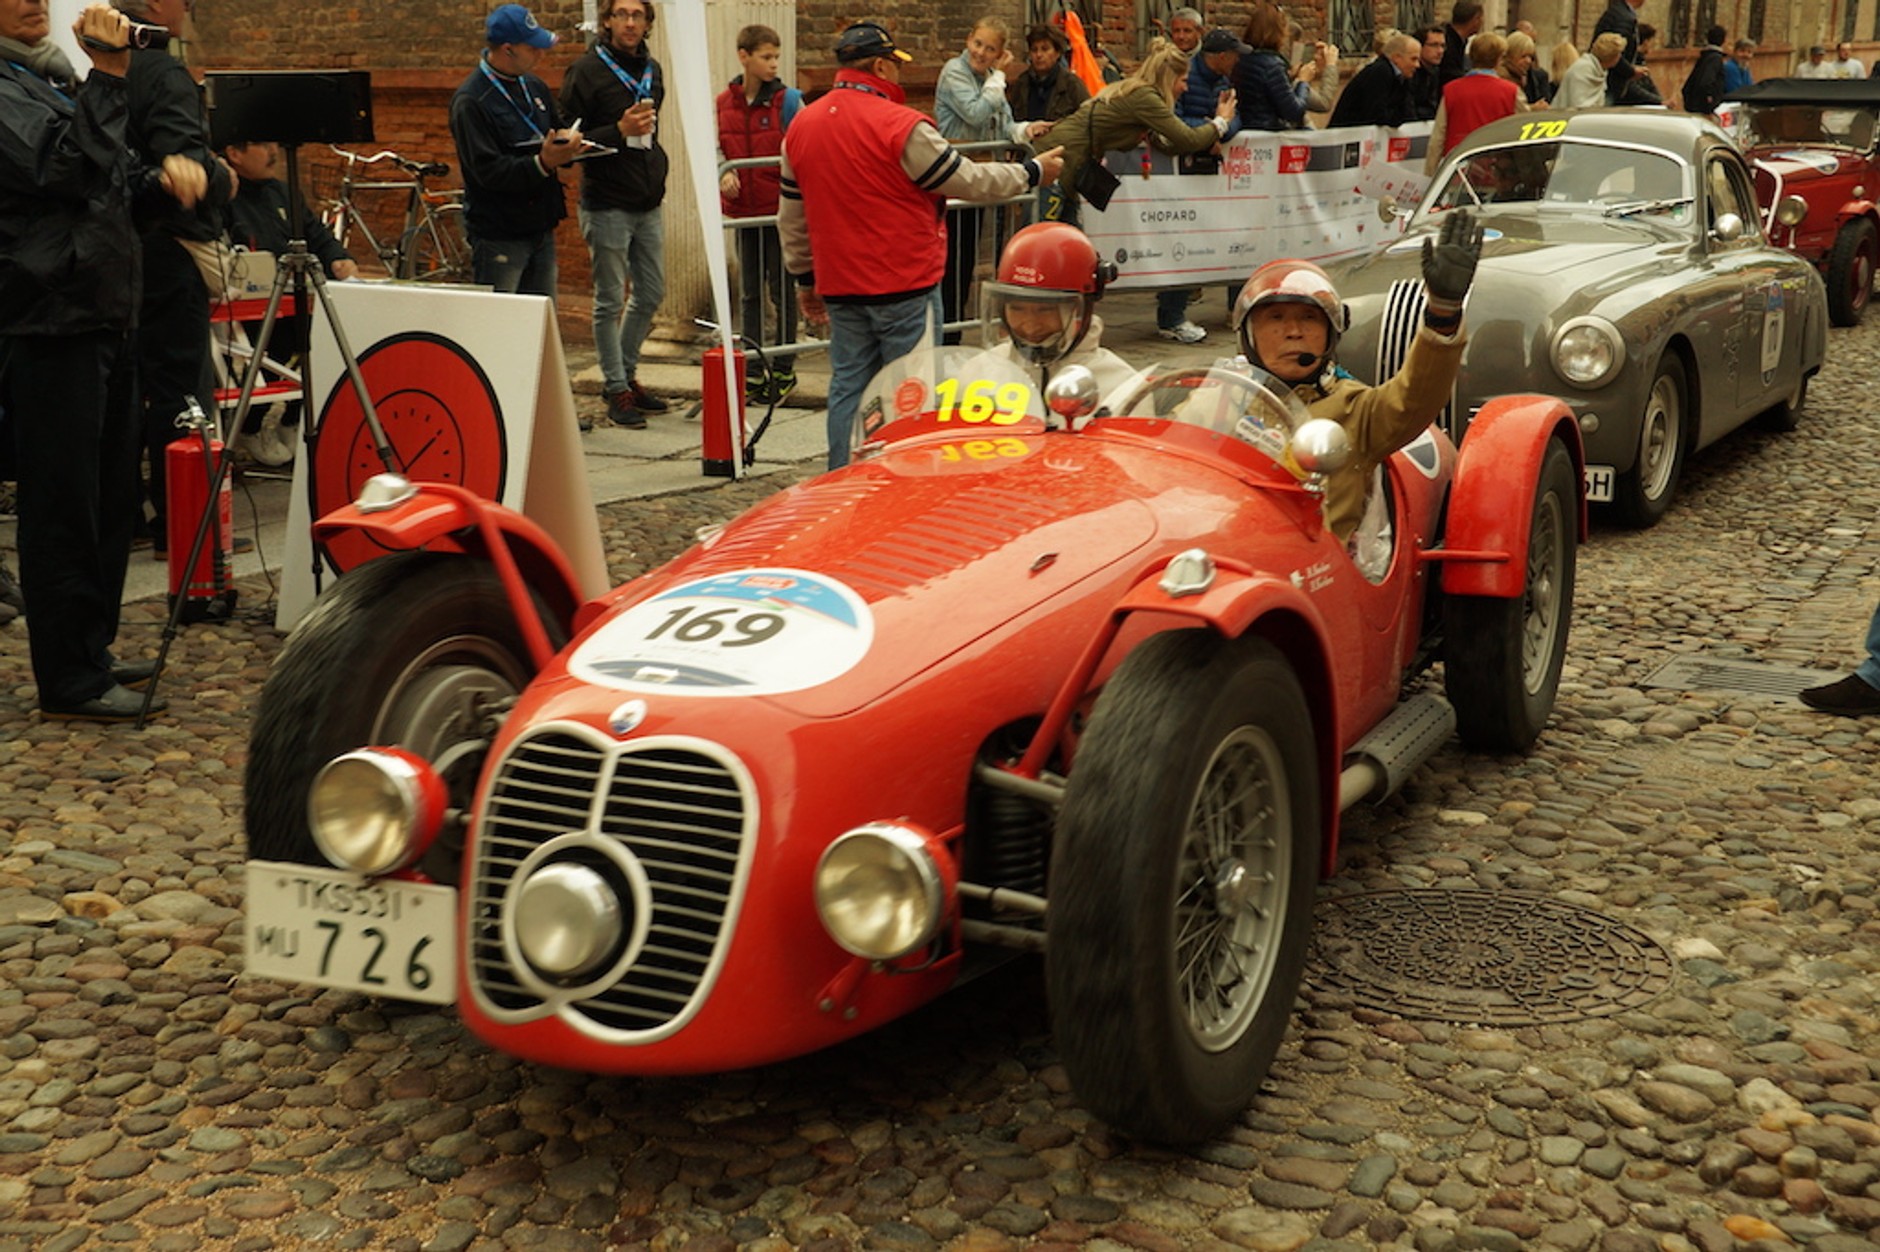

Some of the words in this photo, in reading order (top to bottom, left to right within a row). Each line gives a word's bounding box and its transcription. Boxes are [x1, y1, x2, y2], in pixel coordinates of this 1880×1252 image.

[1520, 120, 1567, 140] 170
[1140, 210, 1197, 223] CHOPARD
[935, 378, 1031, 426] 169
[644, 605, 786, 648] 169
[293, 878, 402, 922] TKS531
[316, 919, 434, 991] 726
